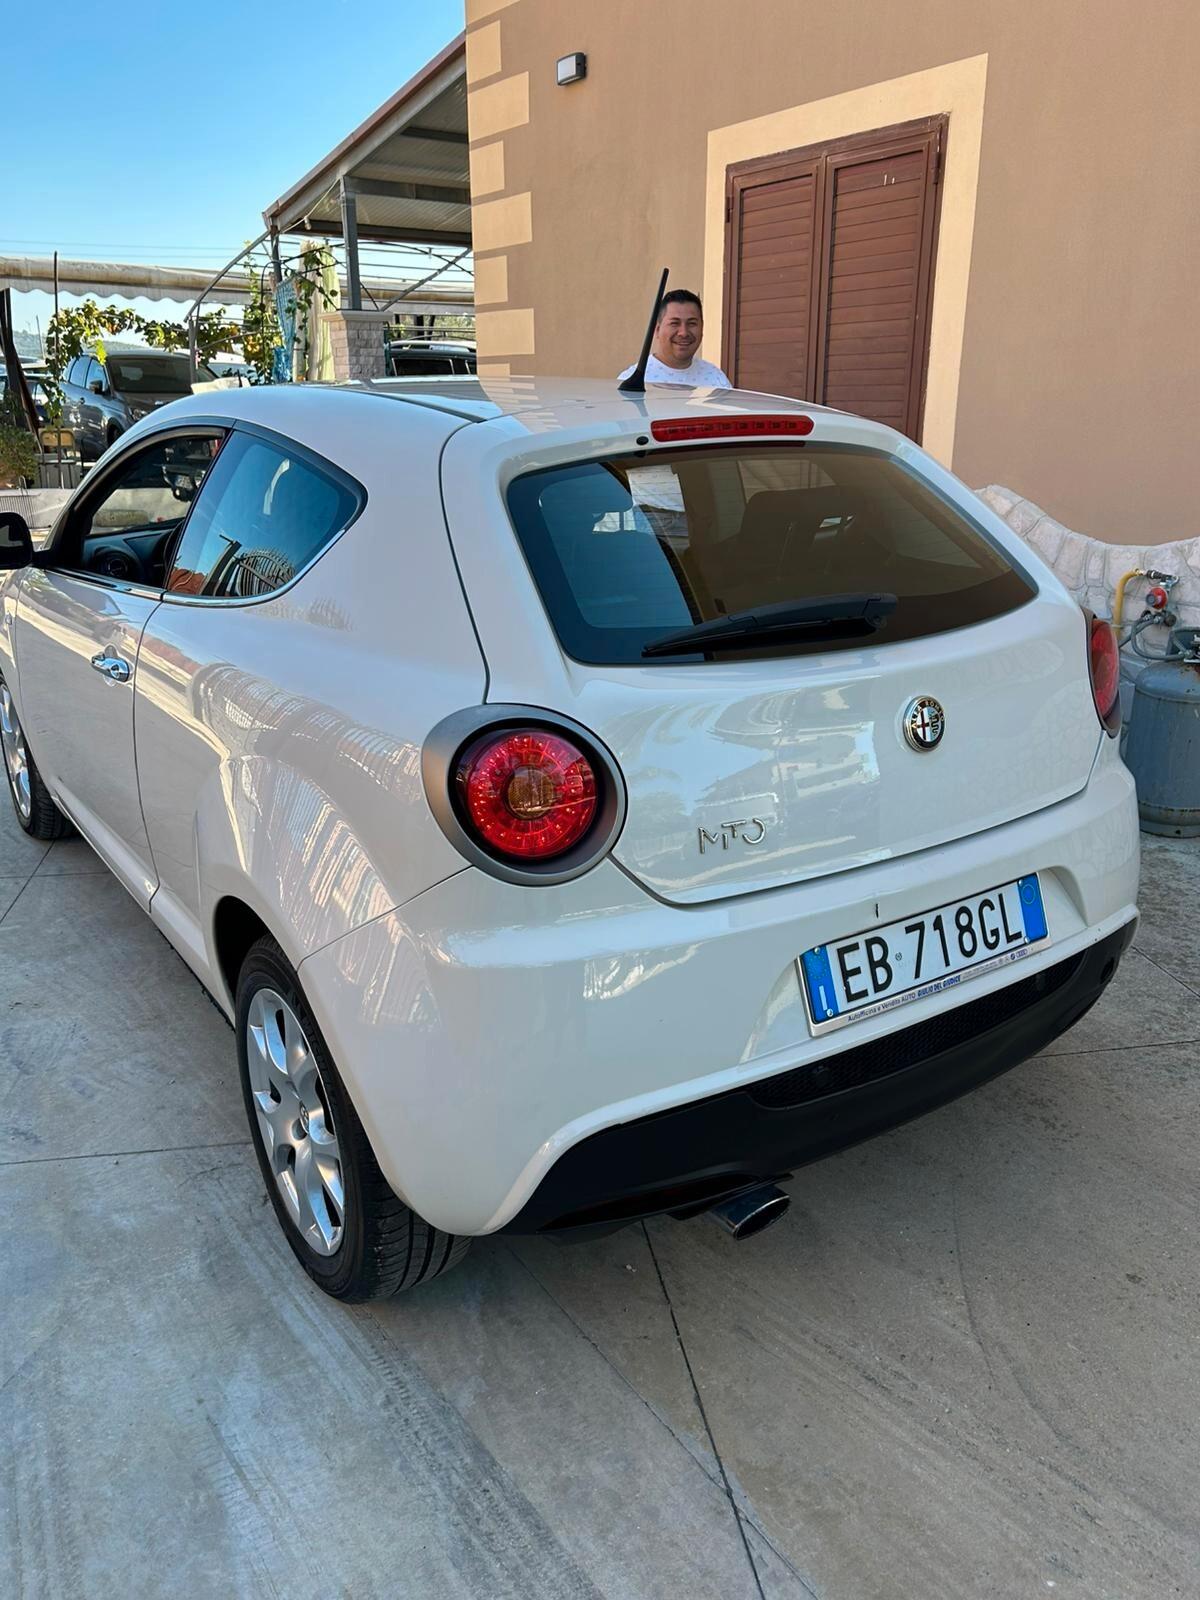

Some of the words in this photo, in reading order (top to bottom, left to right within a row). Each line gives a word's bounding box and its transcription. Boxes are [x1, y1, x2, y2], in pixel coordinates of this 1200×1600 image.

[836, 936, 893, 1003] EB
[905, 893, 1023, 980] 718GL
[901, 992, 916, 1002] AUTO
[917, 984, 934, 998] GIULIO
[933, 982, 943, 993] DEL
